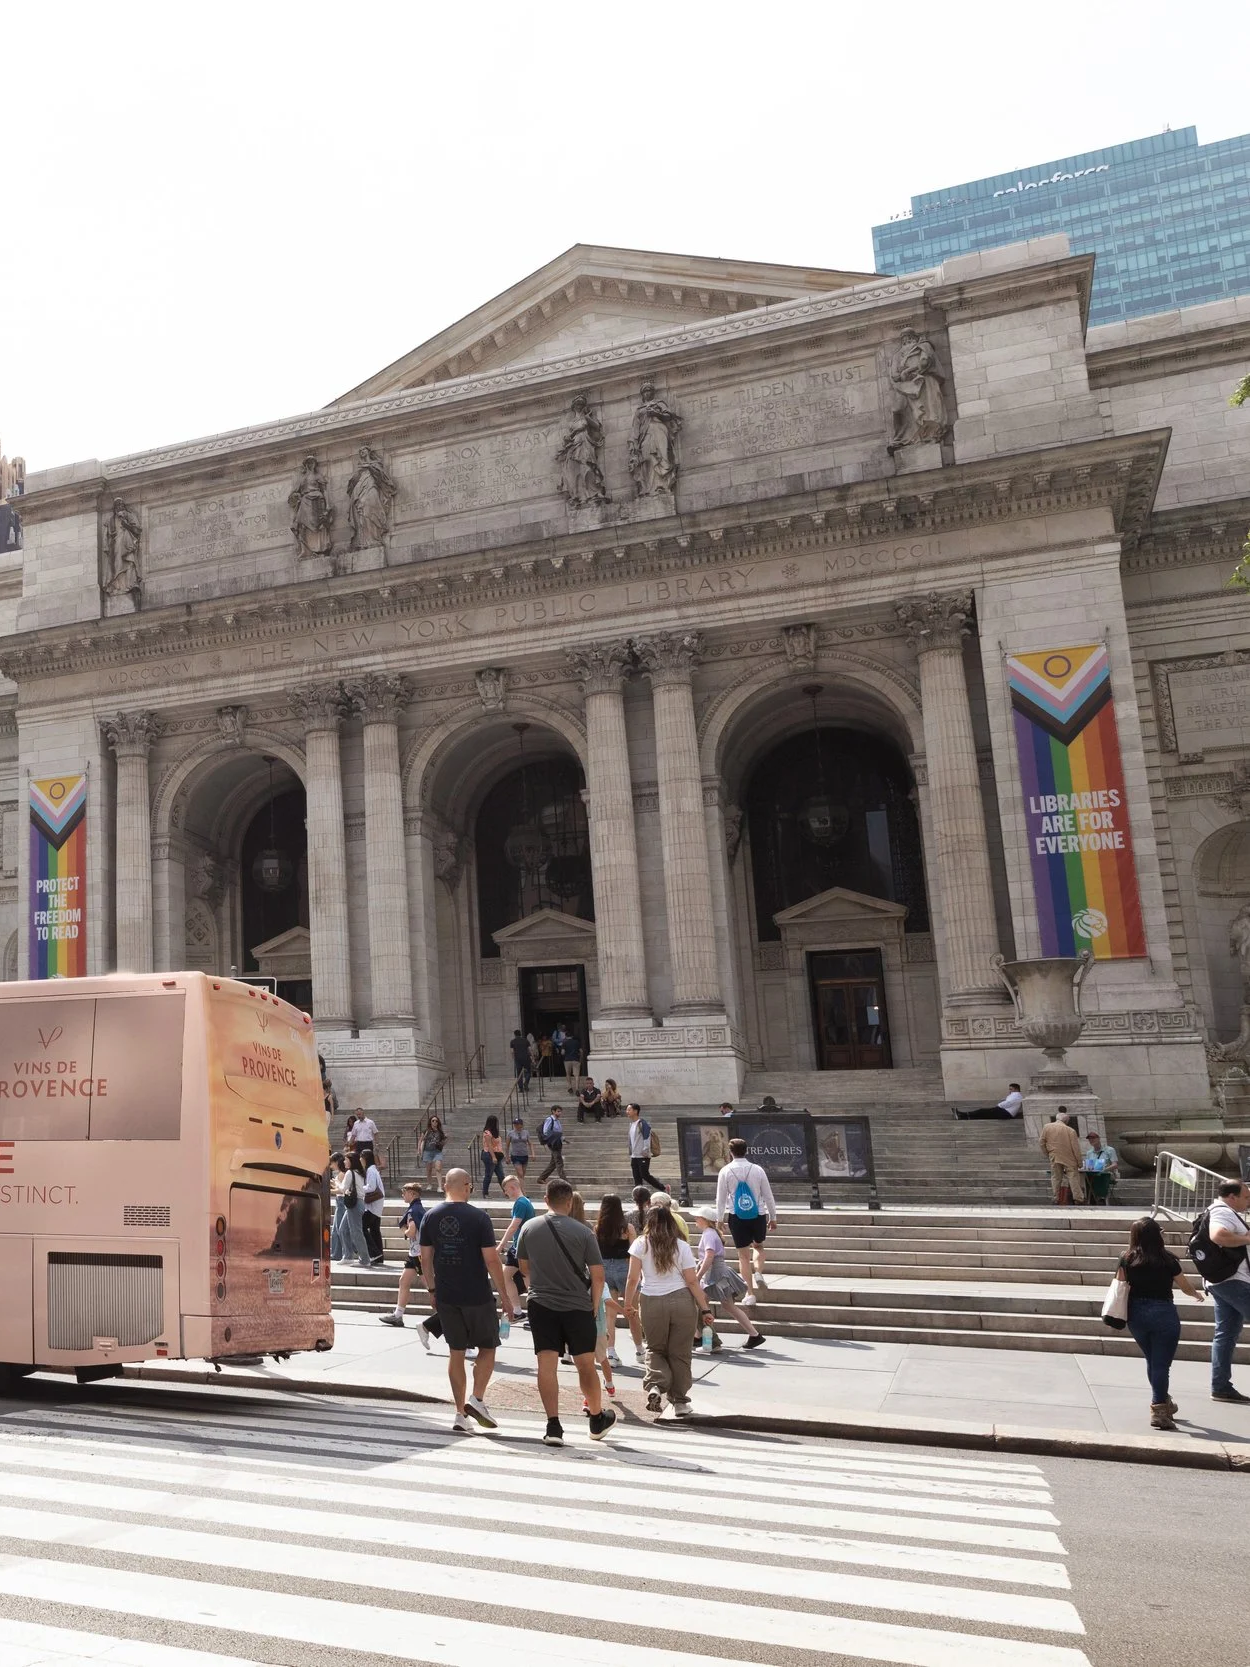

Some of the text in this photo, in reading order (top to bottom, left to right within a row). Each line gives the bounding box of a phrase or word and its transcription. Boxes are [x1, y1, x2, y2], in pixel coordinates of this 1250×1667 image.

[688, 365, 865, 412] THE TILDEN TRUST
[436, 445, 482, 466] LENOX
[490, 430, 551, 454] LIBRARY
[434, 473, 471, 488] JAMES
[532, 476, 554, 488] ARS
[422, 484, 468, 498] DEDICATED
[158, 488, 283, 524] THE ASTOR LIBRARY
[238, 514, 267, 528] ASTOR
[242, 642, 292, 666] THE
[313, 629, 376, 654] NEW
[400, 614, 471, 642] YORK
[495, 594, 596, 626] PUBLIC
[625, 567, 756, 606] LIBRARY
[1030, 789, 1120, 814] LIBRARIES
[1042, 811, 1114, 834] ARE FOR
[1036, 831, 1125, 855] EVERYONE
[36, 876, 80, 894] PROTECT
[48, 894, 68, 908] THE
[34, 908, 82, 926] FREEDOM
[36, 925, 78, 940] TO READ
[252, 1042, 282, 1061] VINS DE
[14, 1060, 77, 1075] VINS DE
[242, 1056, 297, 1087] PROVENCE
[746, 1146, 802, 1155] TREASURES
